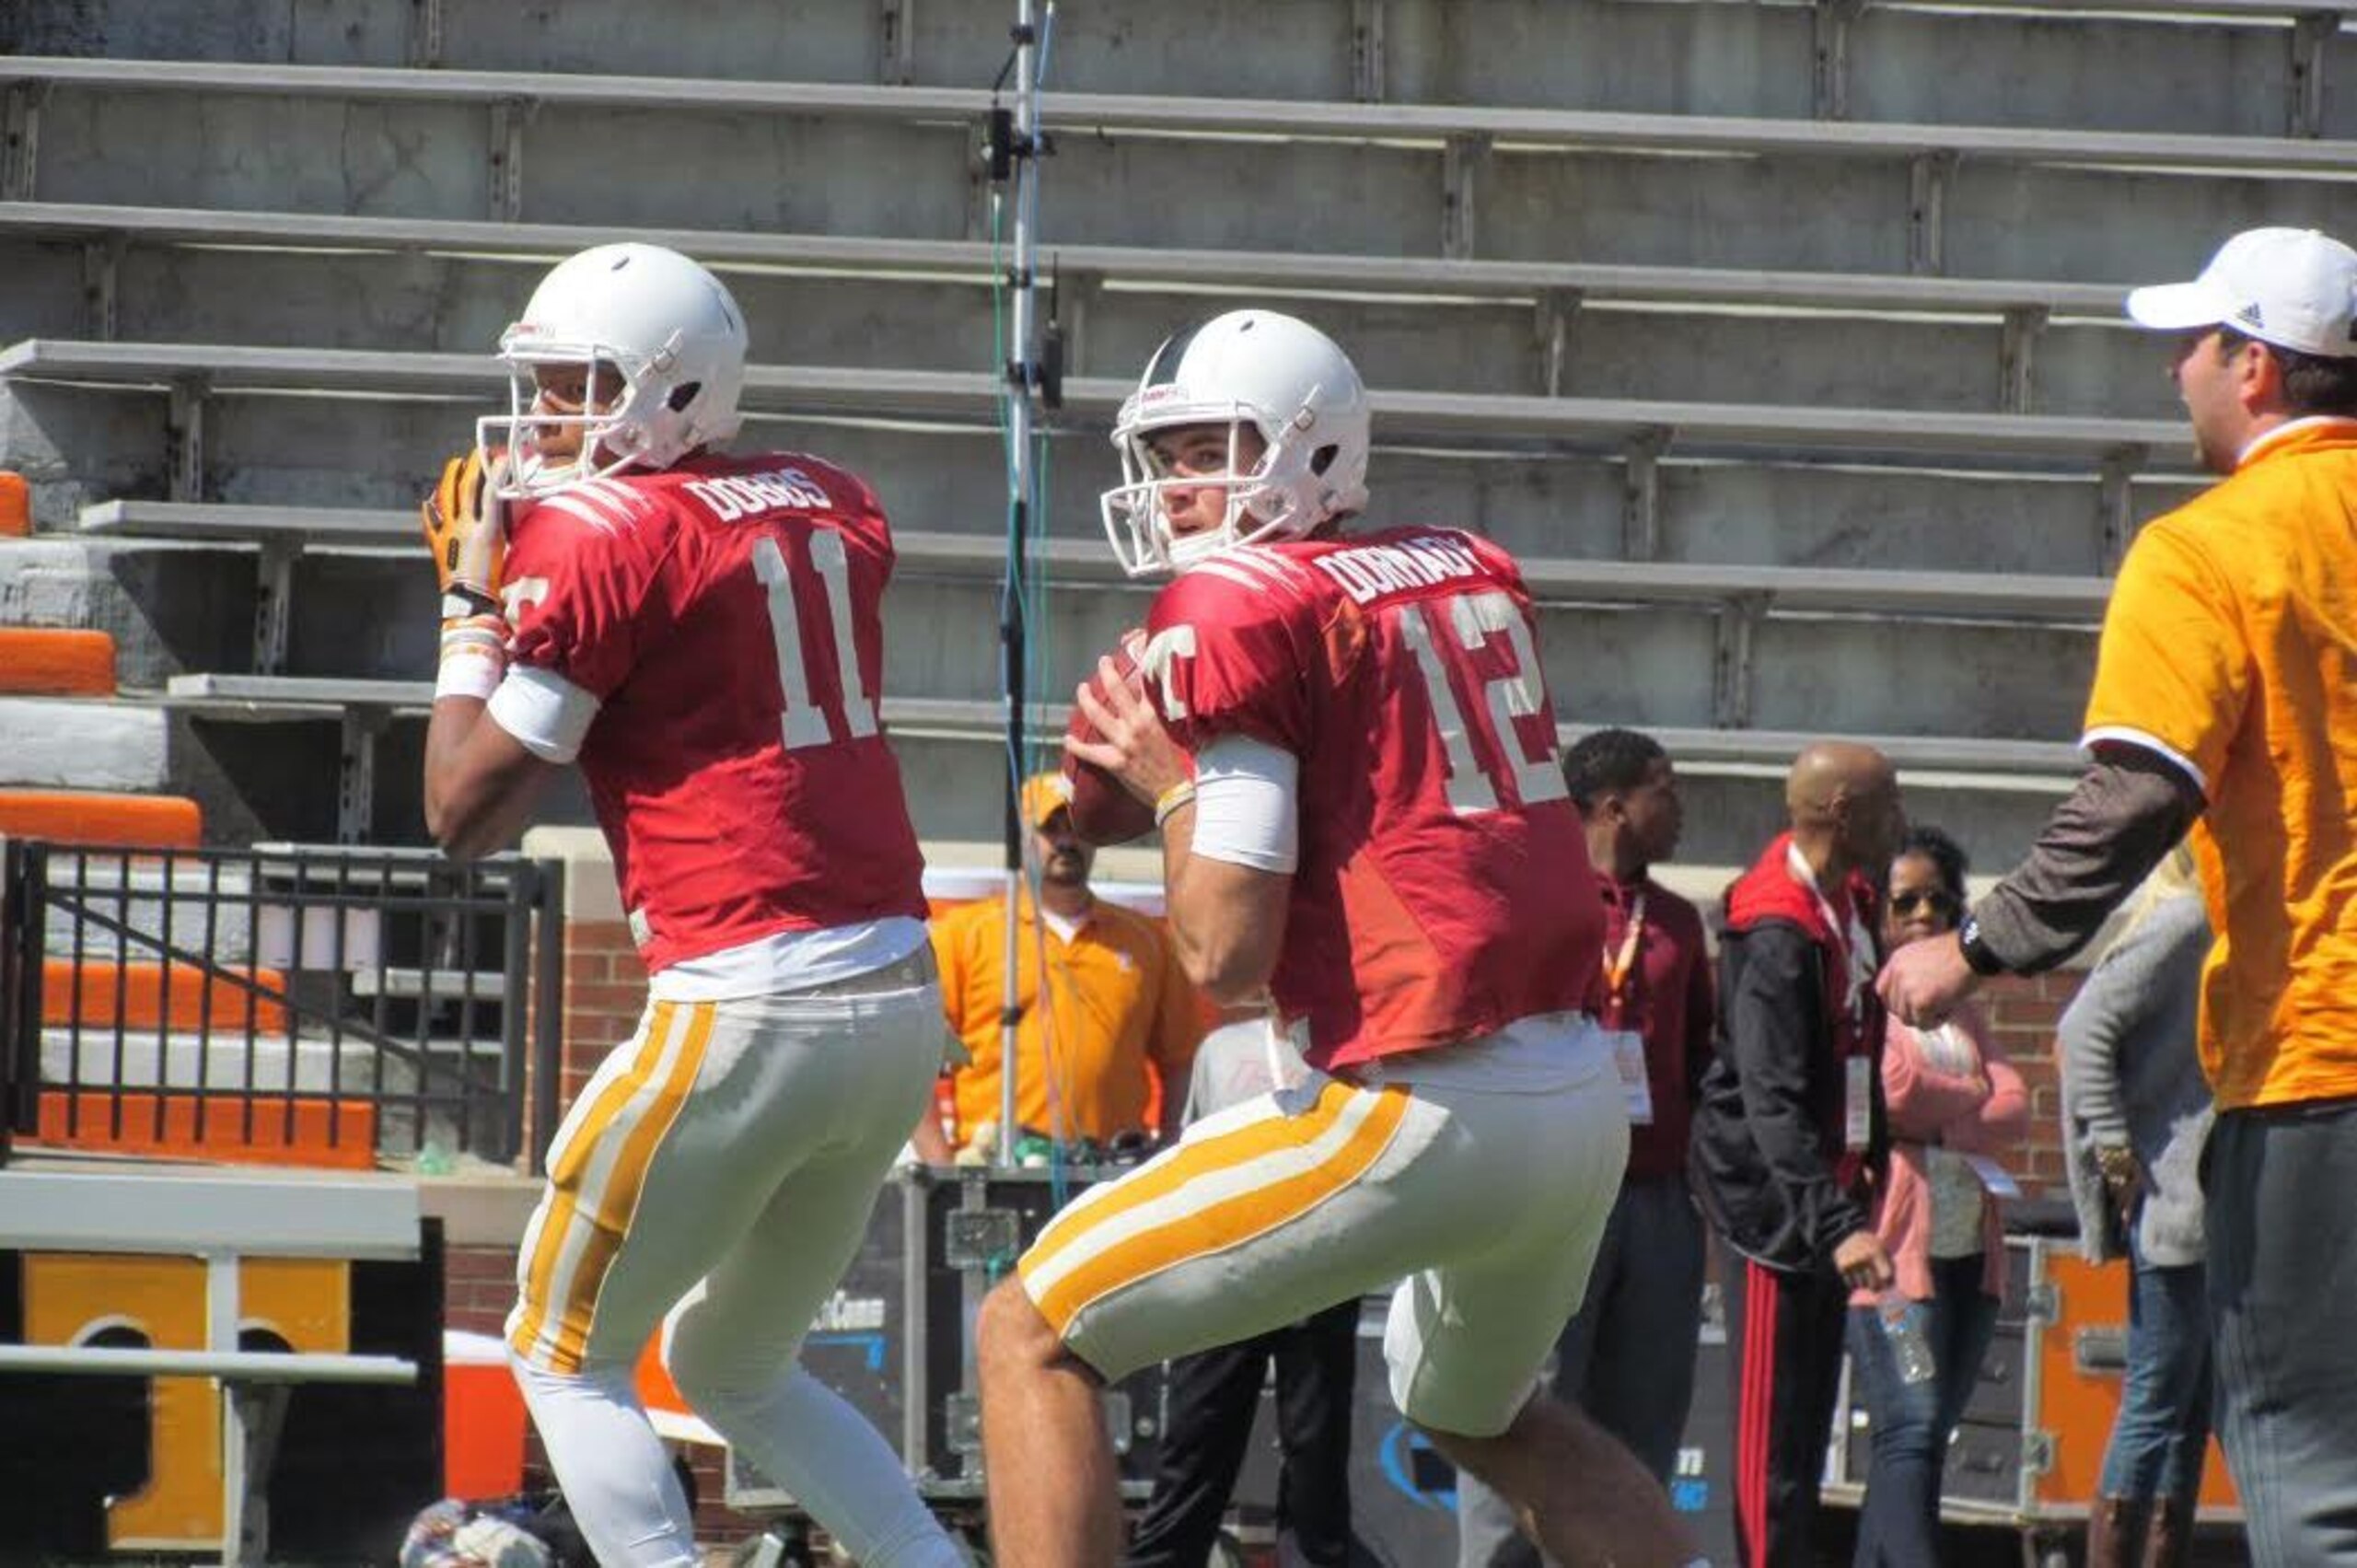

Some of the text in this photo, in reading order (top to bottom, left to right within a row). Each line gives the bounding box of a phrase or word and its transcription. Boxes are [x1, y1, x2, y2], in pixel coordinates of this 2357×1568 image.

[681, 467, 832, 521] DOBBS
[751, 528, 878, 750] 11
[1311, 536, 1492, 604] DORMADY
[1399, 592, 1570, 817] 12
